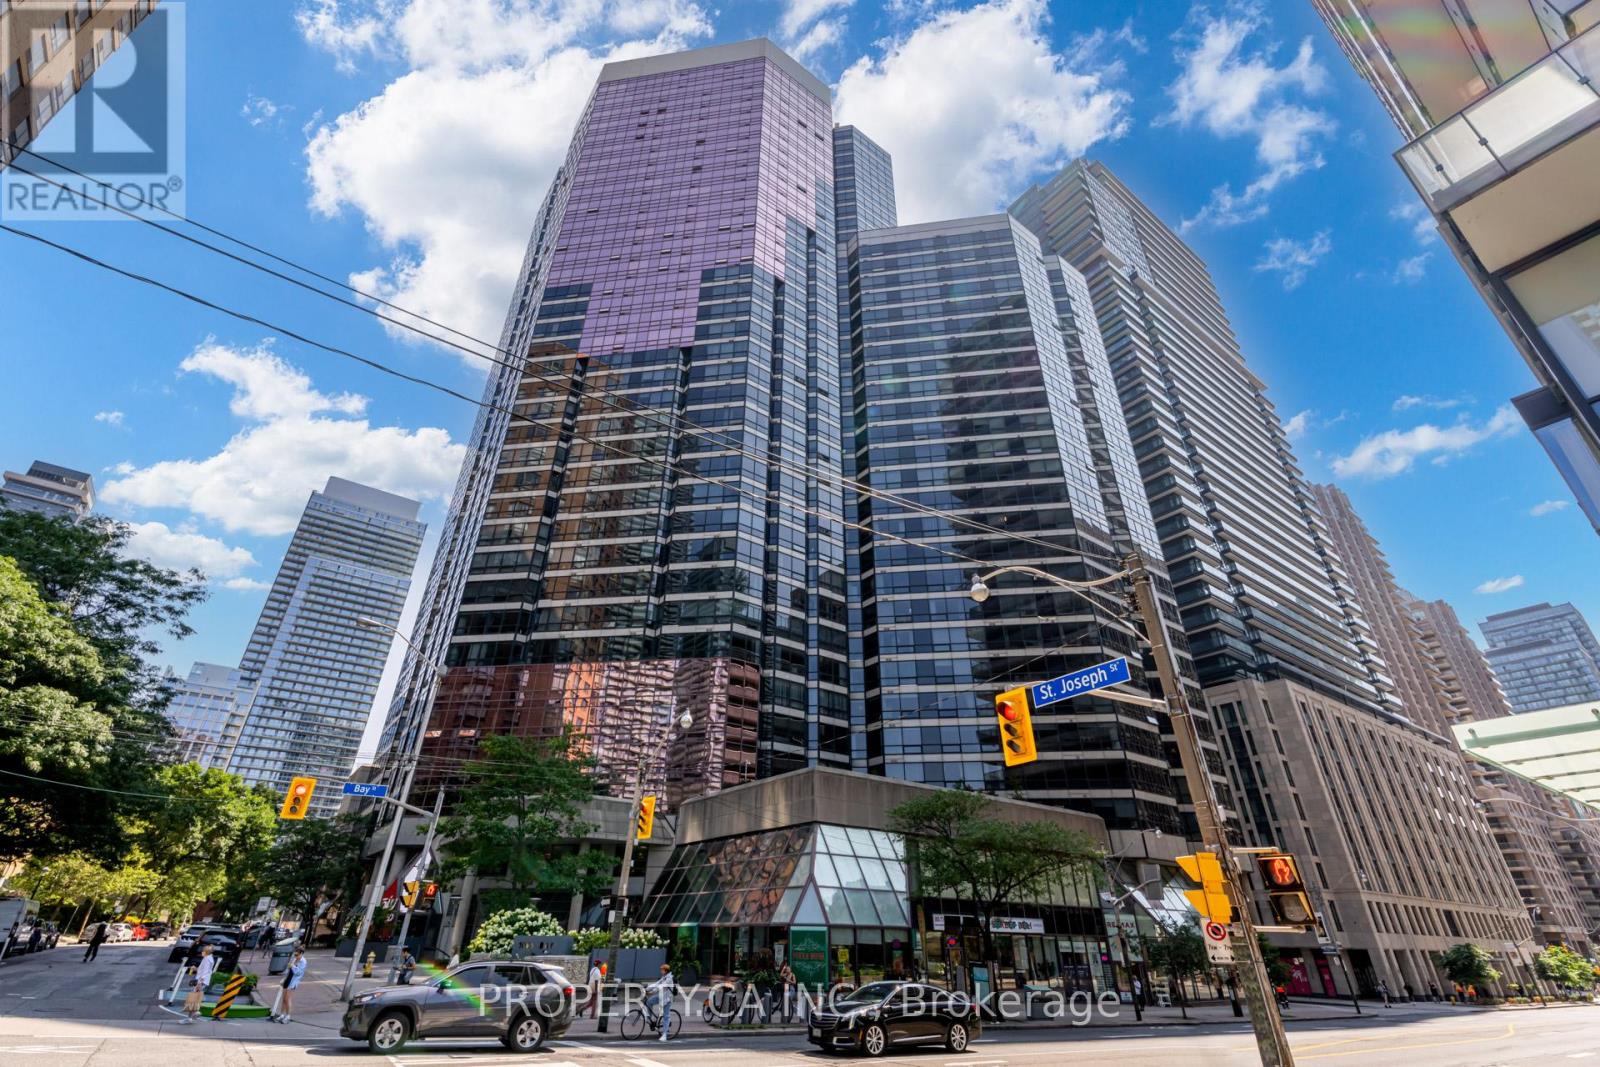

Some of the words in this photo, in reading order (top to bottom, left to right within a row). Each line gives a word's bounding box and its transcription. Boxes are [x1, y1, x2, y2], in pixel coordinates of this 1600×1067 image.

[1039, 684, 1057, 700] St.
[1060, 668, 1108, 694] Joseph
[353, 784, 370, 796] Bay
